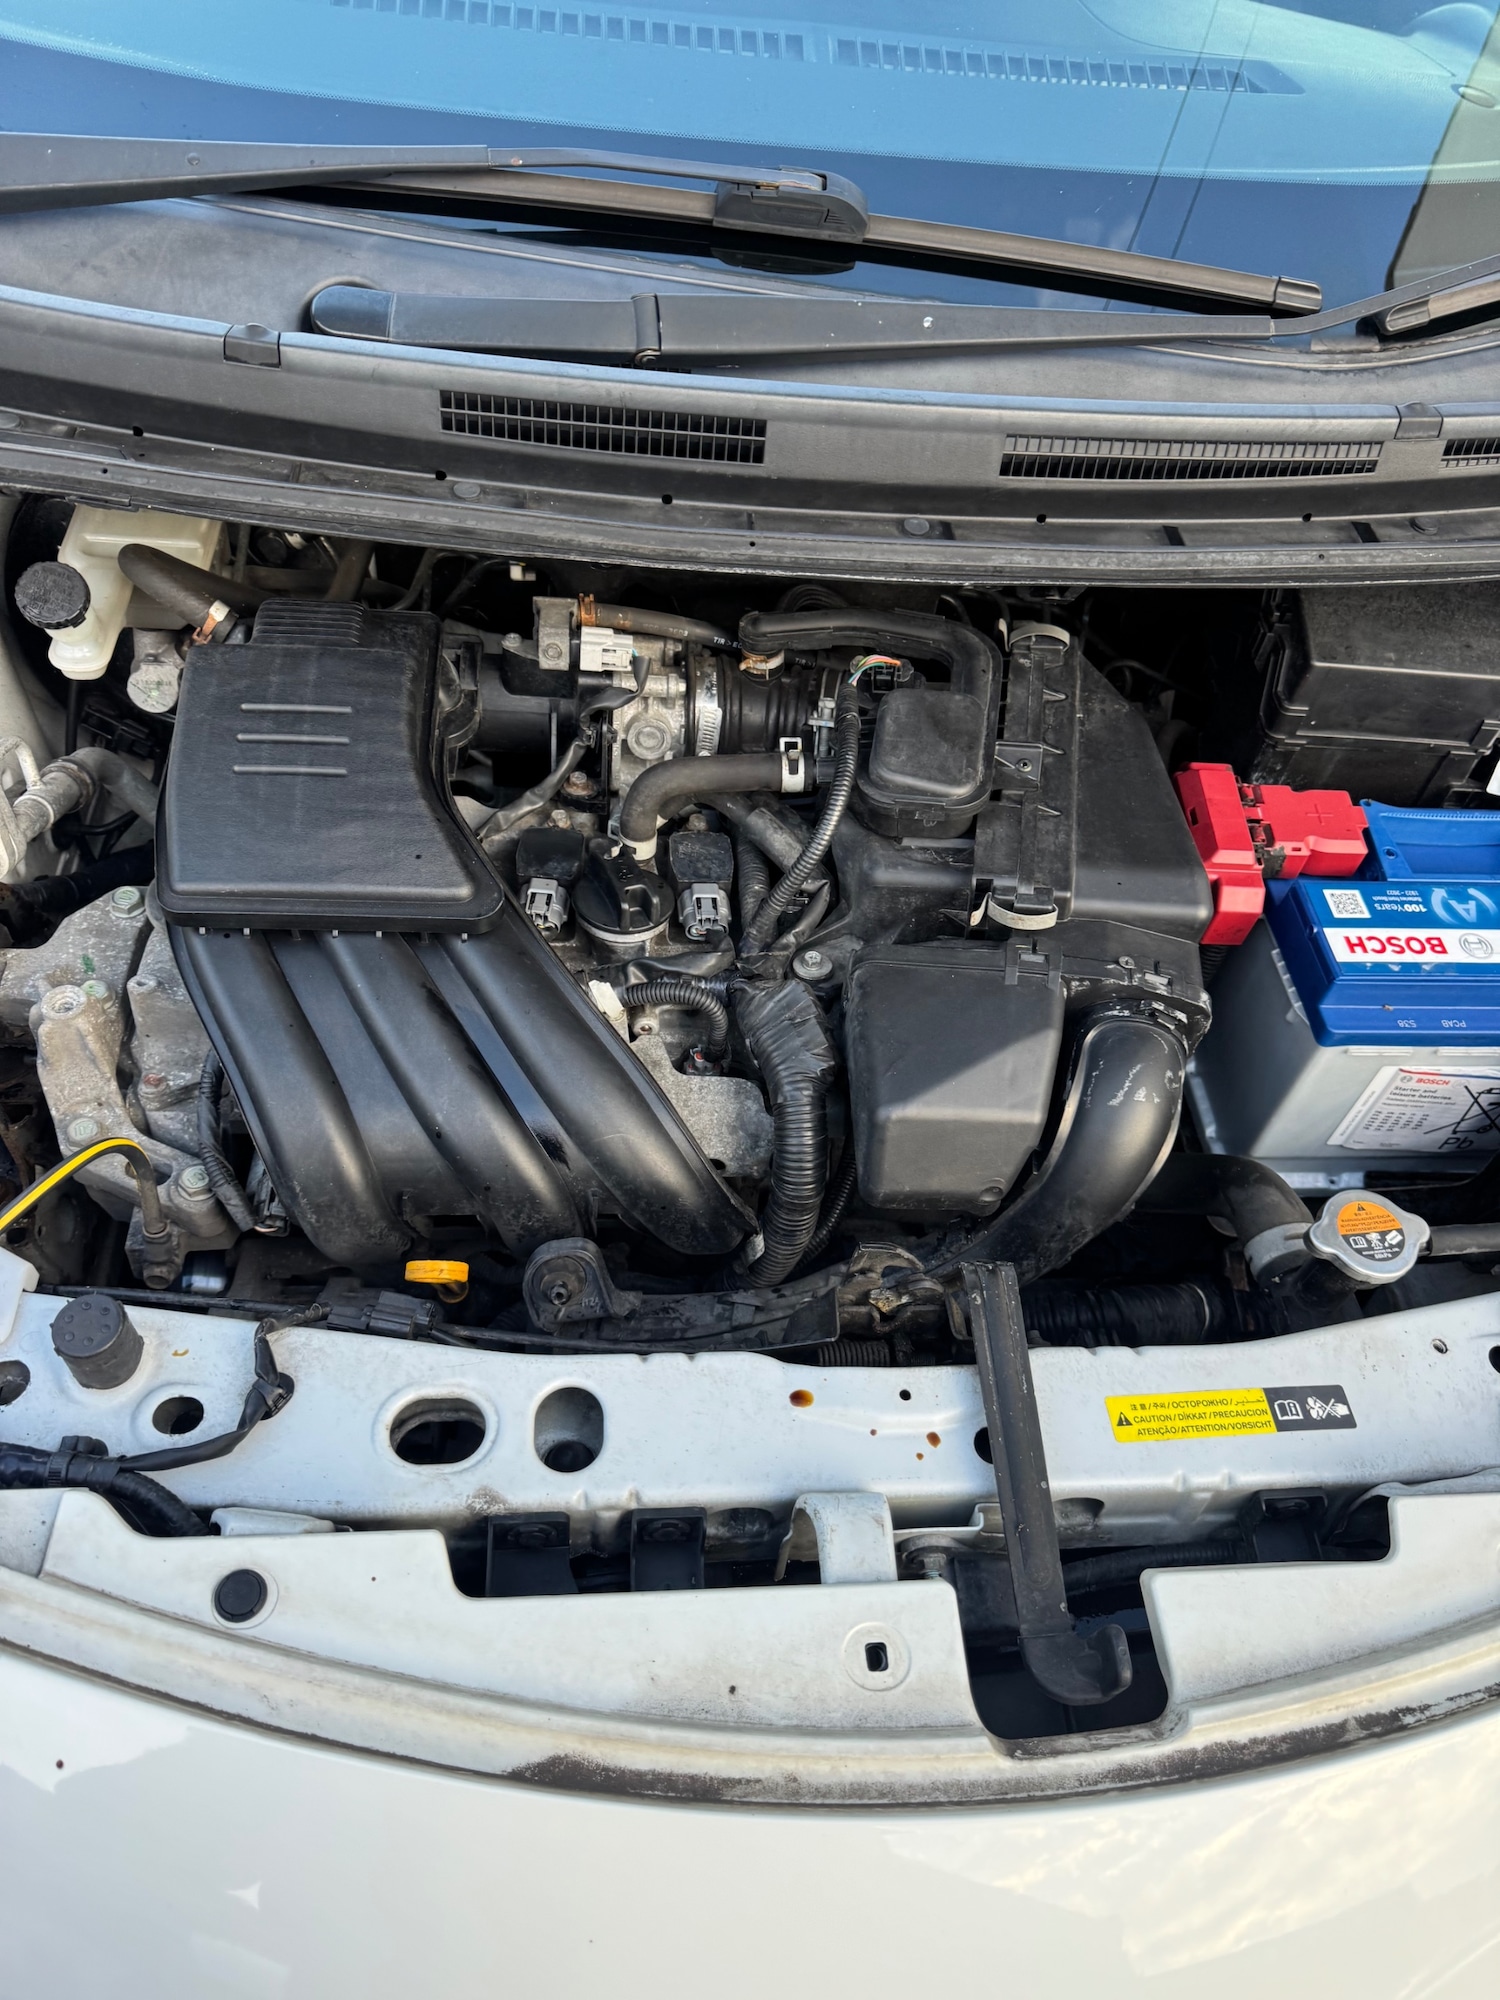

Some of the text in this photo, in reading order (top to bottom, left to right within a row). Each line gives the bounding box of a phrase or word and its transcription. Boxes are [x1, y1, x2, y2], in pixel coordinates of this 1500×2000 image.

[1343, 936, 1449, 955] BOSCH
[1441, 1019, 1467, 1028] PCAB
[1415, 1077, 1450, 1086] BOSCH
[1393, 1085, 1421, 1093] Starter
[1438, 1136, 1474, 1150] Pb
[1133, 1415, 1172, 1424] CAUTION
